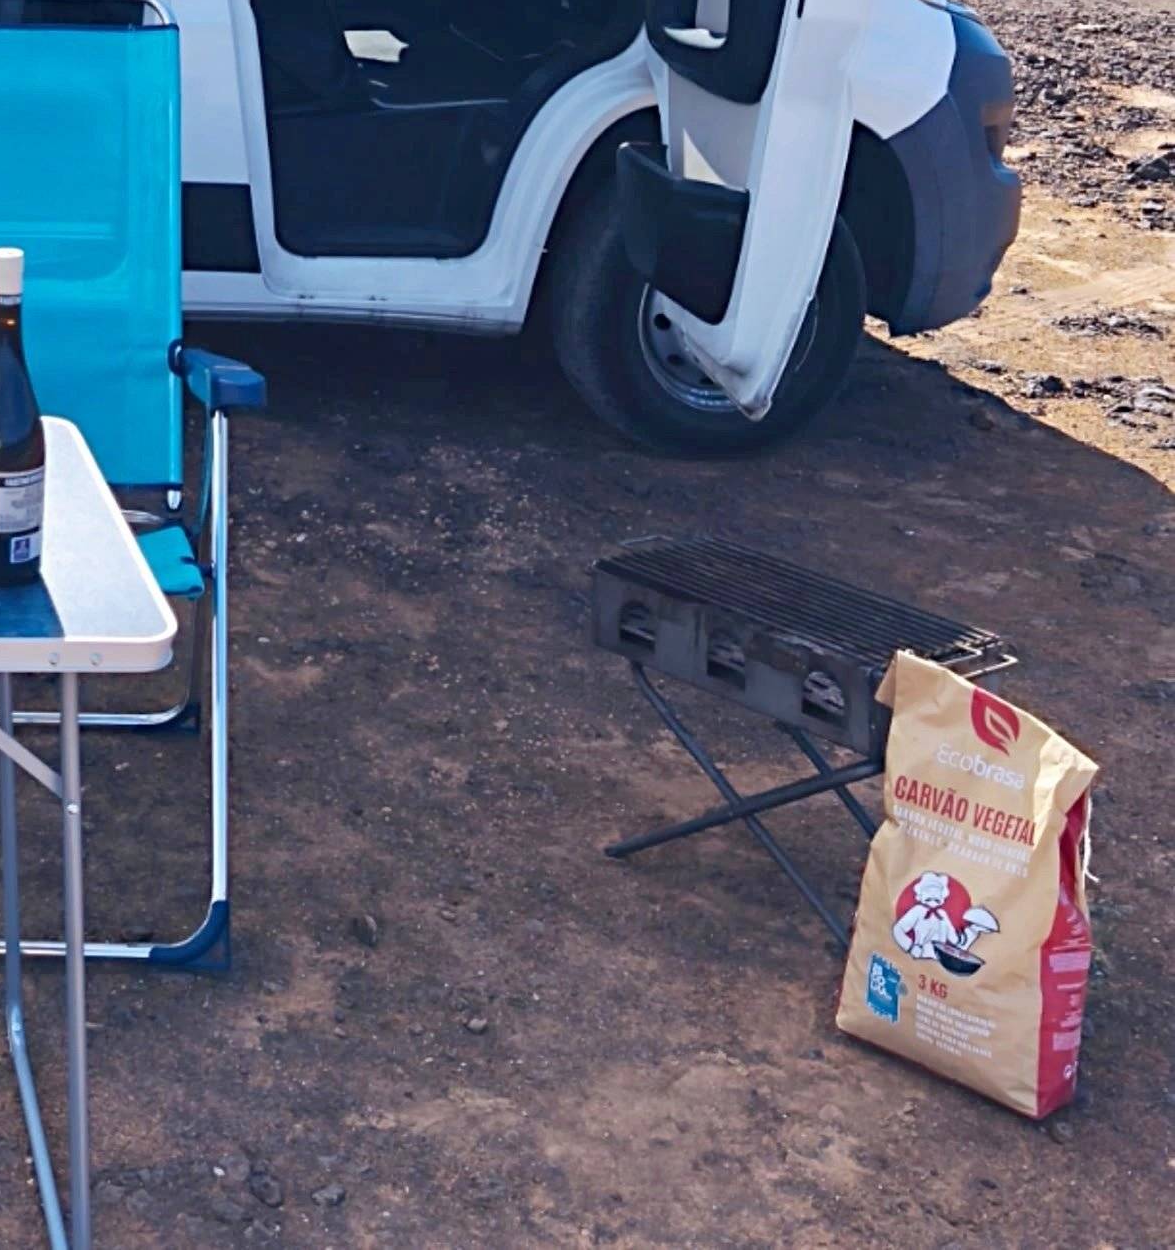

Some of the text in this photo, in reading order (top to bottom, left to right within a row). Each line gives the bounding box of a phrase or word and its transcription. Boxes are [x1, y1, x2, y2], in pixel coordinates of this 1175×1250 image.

[935, 743, 1025, 792] Ecobrasa
[894, 775, 970, 822] CARVÃO
[975, 803, 1037, 847] VEGETAL
[918, 974, 948, 999] 3 KG
